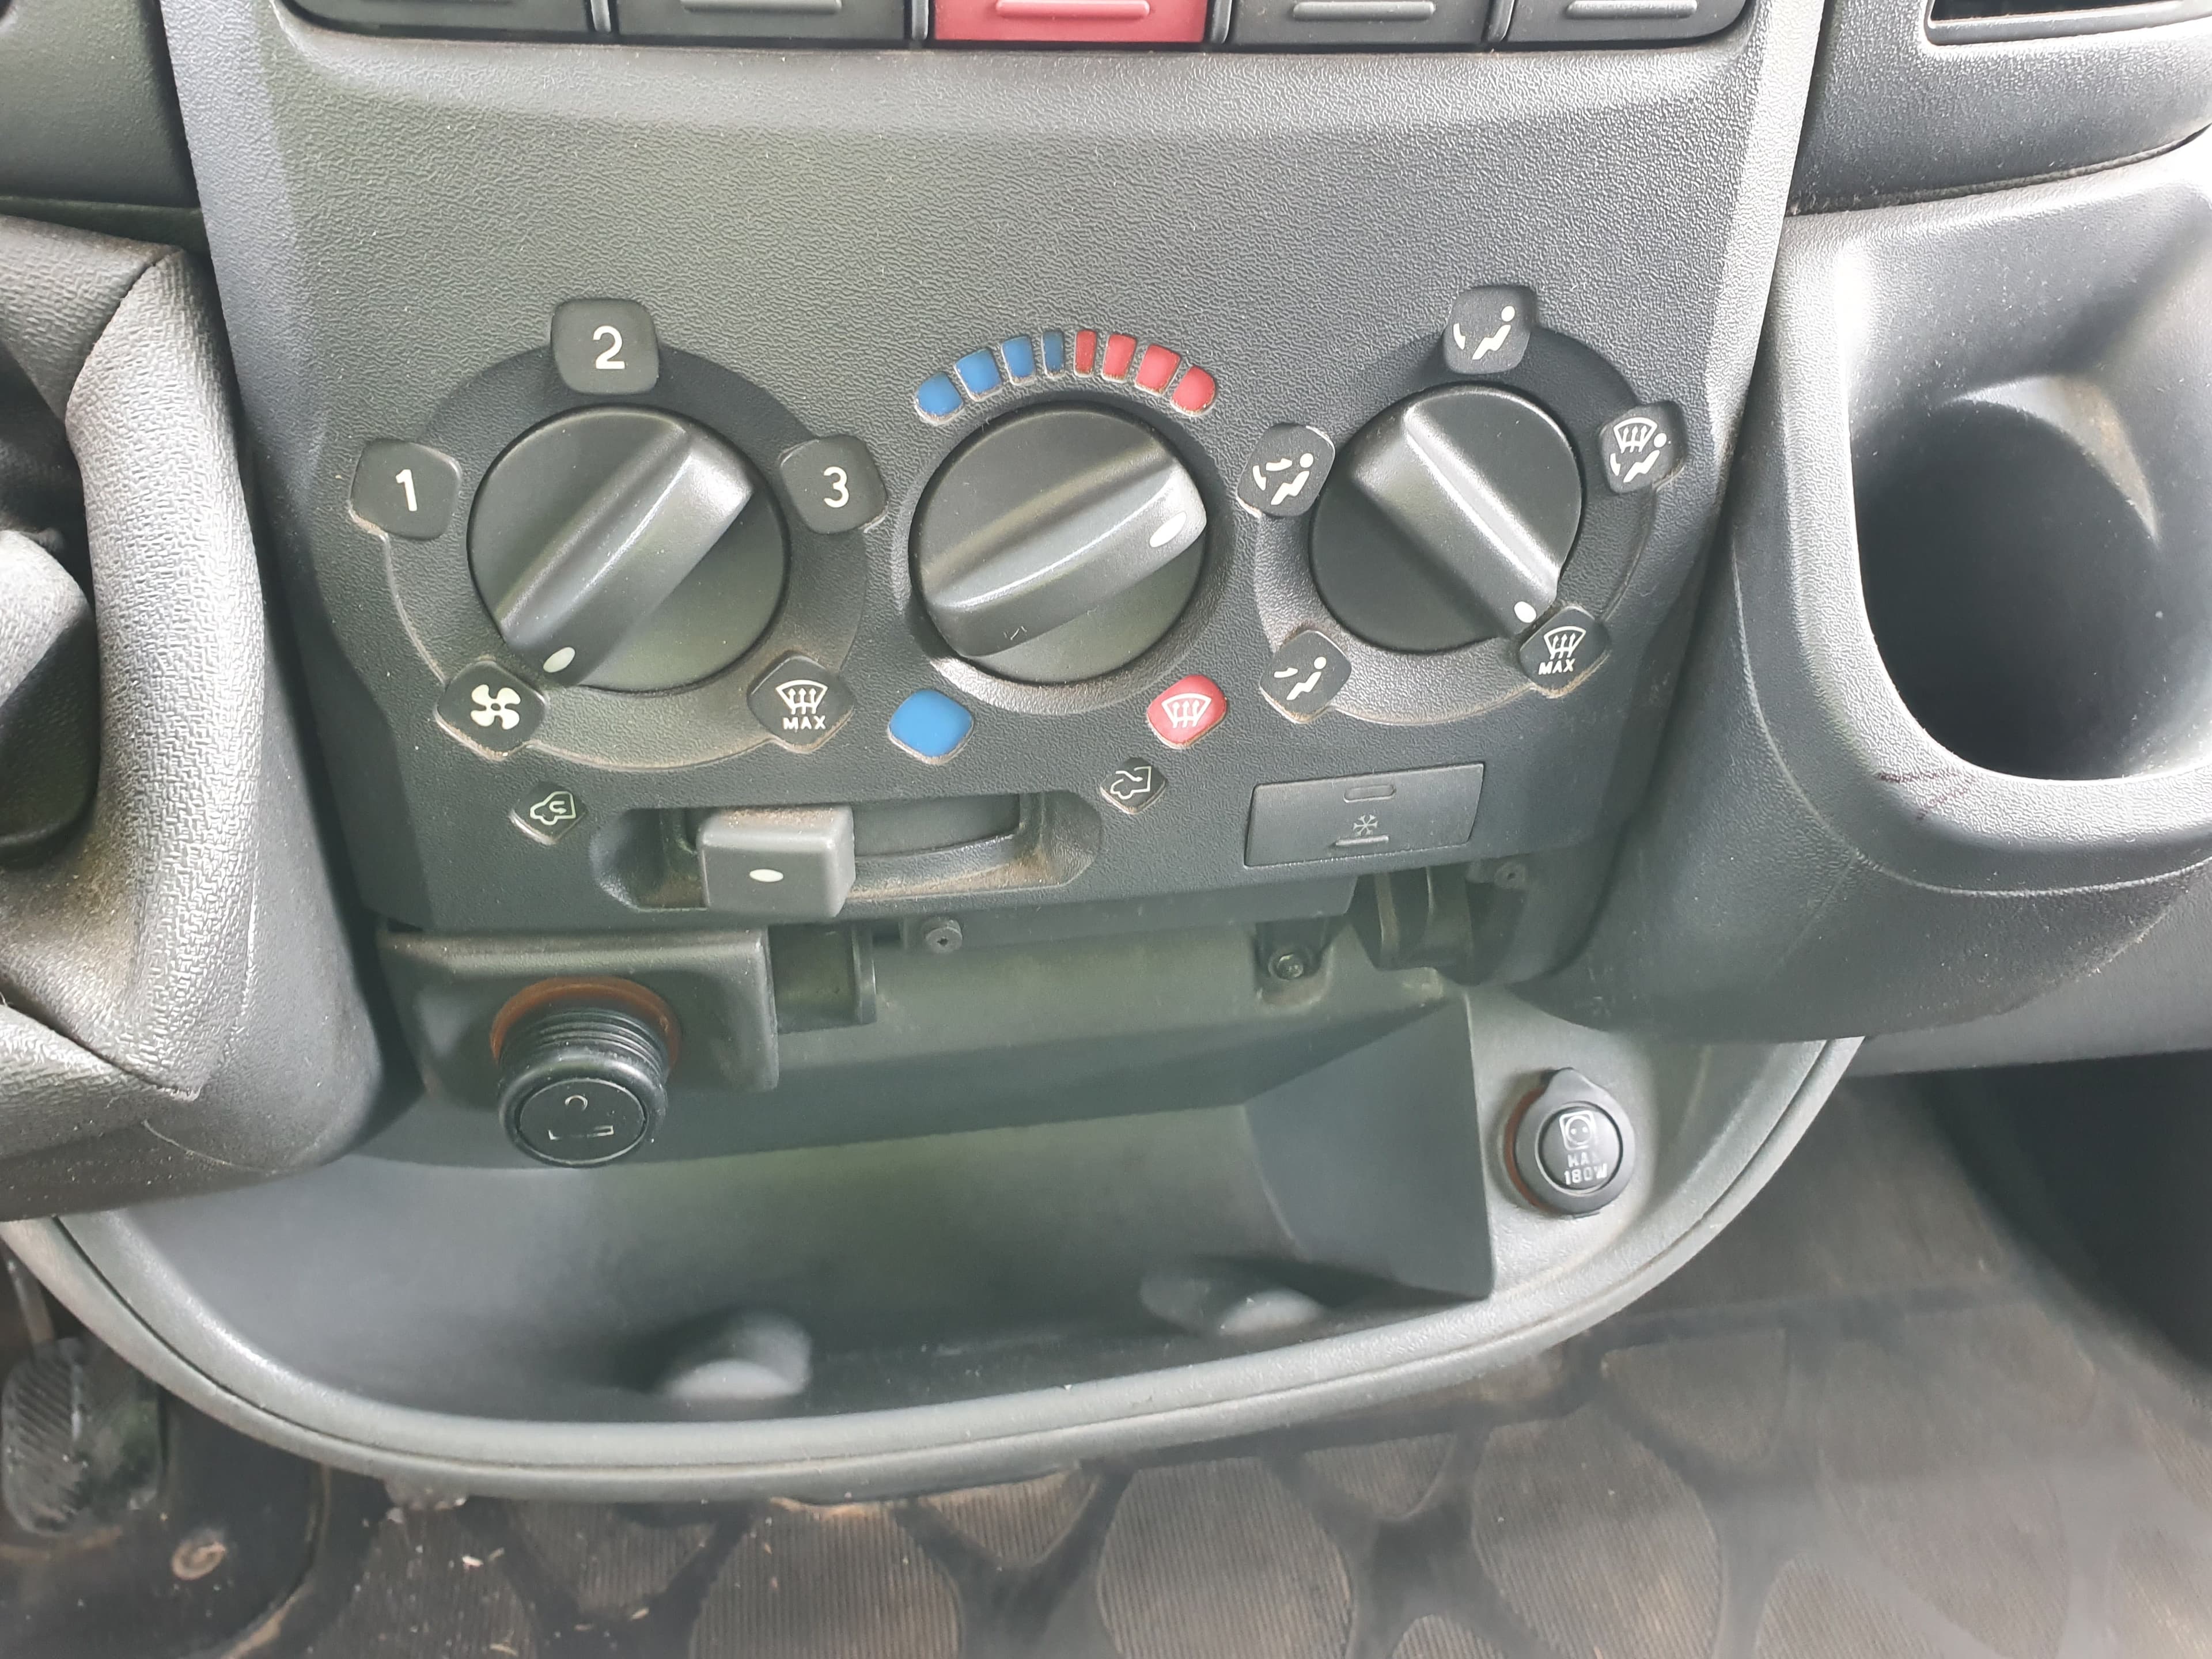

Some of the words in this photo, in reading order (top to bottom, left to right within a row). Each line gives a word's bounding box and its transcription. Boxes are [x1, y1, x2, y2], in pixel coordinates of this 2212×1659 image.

[592, 325, 626, 370] 2
[395, 469, 418, 512] 1
[823, 465, 849, 508] 3
[1538, 658, 1575, 675] MAX
[783, 715, 826, 730] MAX
[1564, 1163, 1608, 1185] 180W
